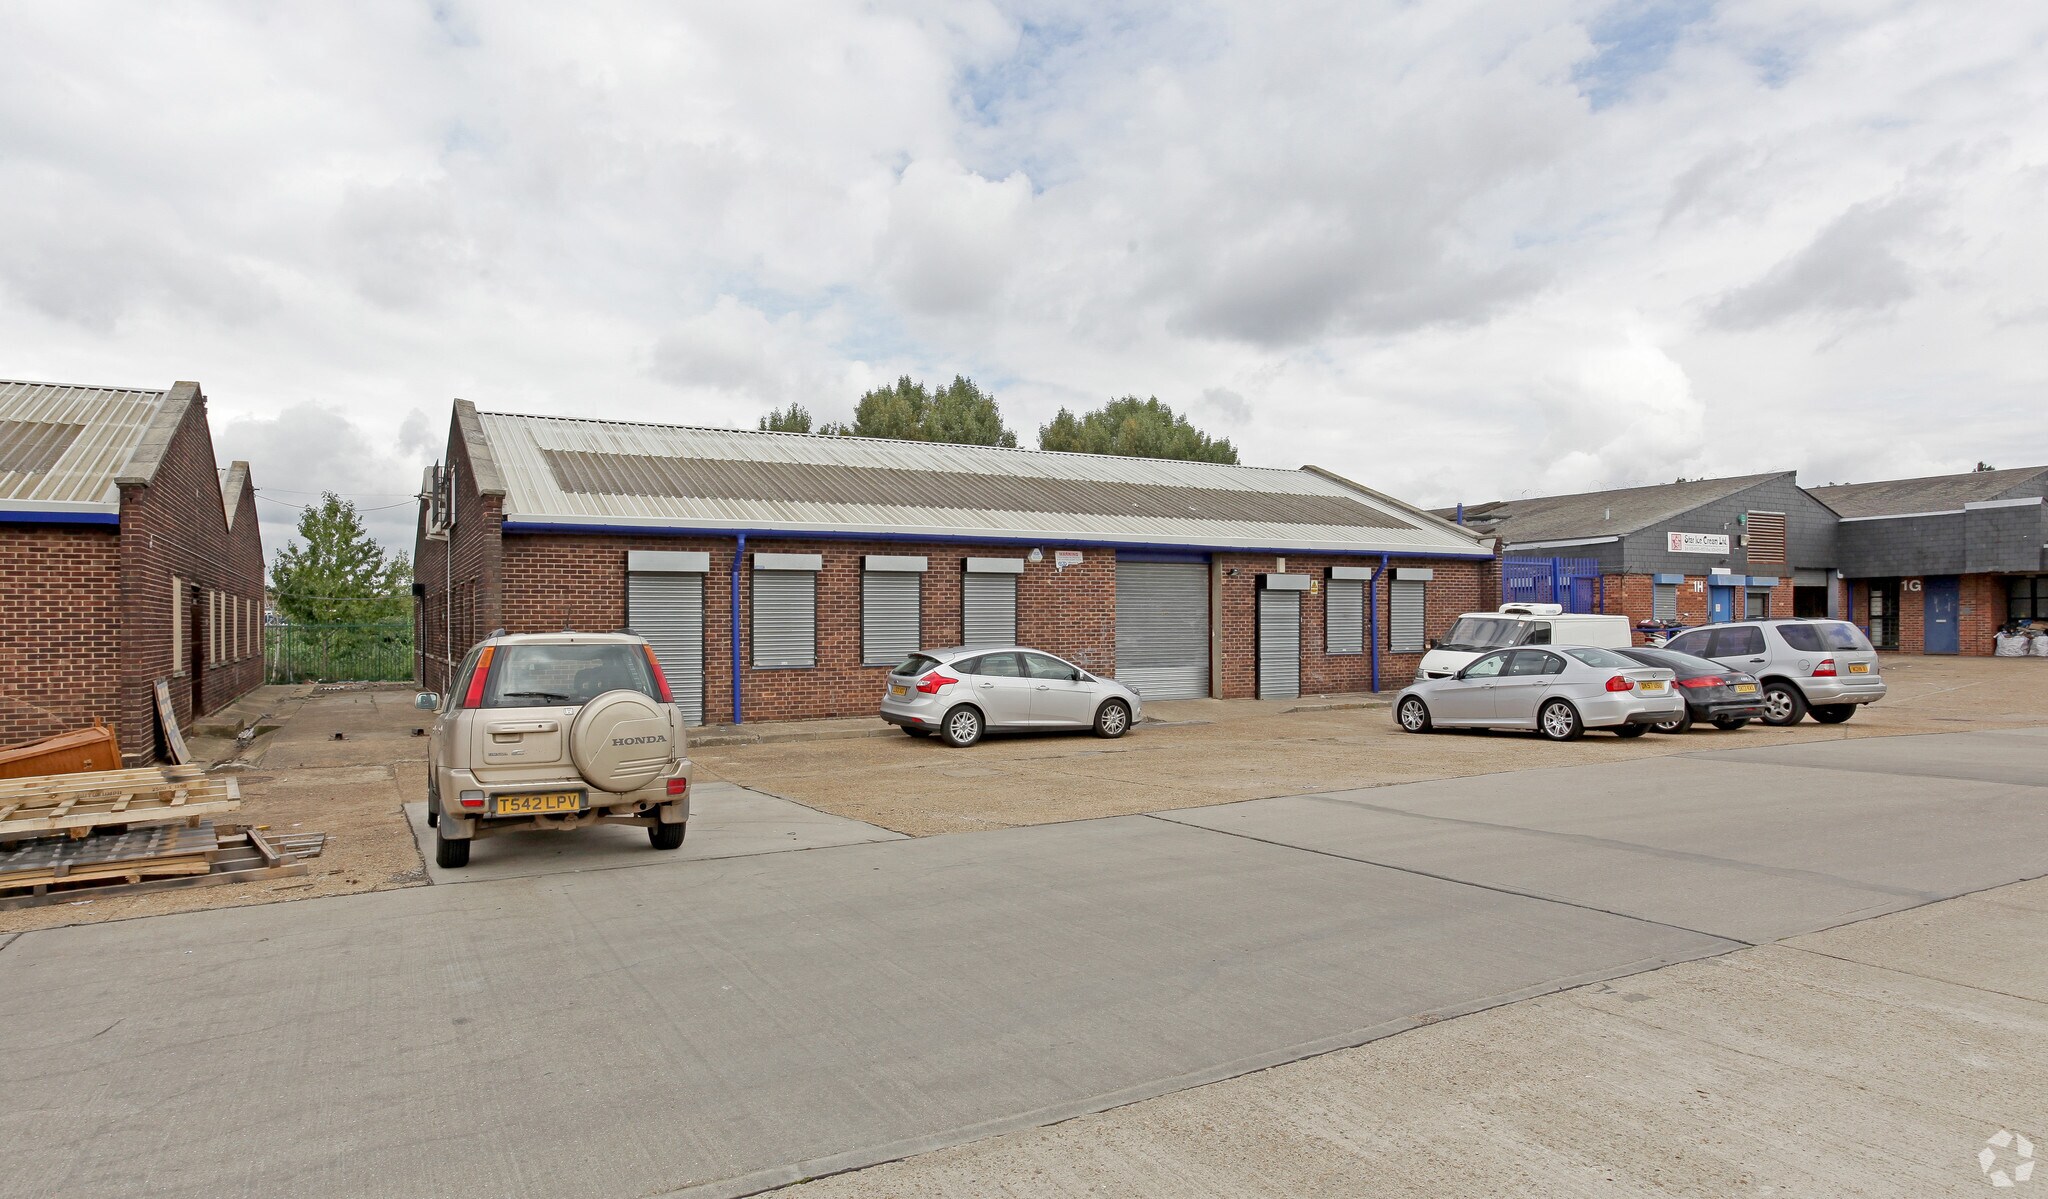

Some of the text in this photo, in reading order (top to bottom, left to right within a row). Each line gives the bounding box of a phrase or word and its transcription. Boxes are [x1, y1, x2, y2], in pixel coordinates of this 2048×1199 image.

[1684, 535, 1695, 544] Star
[1695, 536, 1703, 544] Ice
[1703, 536, 1718, 545] Cream
[1693, 580, 1704, 593] 1H
[1901, 580, 1921, 592] 1G
[612, 735, 667, 747] HONDA
[499, 795, 577, 812] T542 LPV
